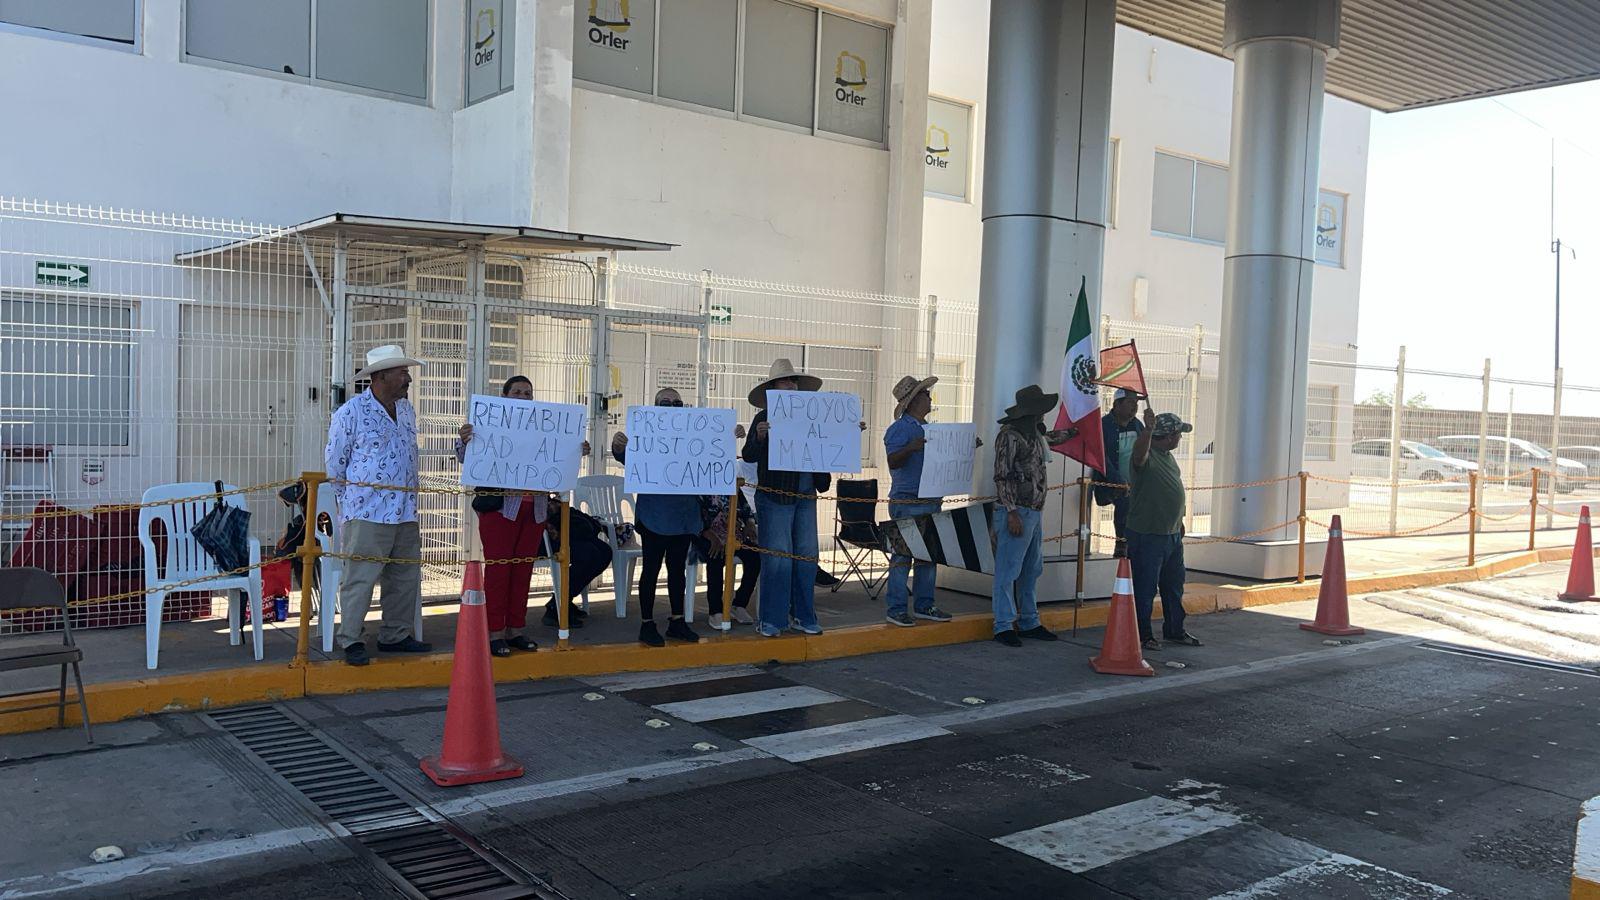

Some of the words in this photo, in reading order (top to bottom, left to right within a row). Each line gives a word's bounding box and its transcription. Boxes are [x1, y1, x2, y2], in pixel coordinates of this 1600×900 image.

[589, 27, 629, 50] Orler
[475, 48, 495, 66] Orler
[835, 87, 866, 106] Orler
[925, 154, 949, 169] Orler
[1316, 234, 1336, 248] Orler
[773, 393, 859, 423] APOYOS
[633, 409, 725, 433] PRECIOS
[807, 422, 828, 439] AL
[471, 432, 514, 459] DAD
[534, 437, 564, 463] AL
[628, 435, 726, 458] JUSTOS
[779, 439, 847, 471] MAIZ
[469, 460, 563, 490] CAMPO
[629, 462, 658, 485] AL
[662, 459, 735, 488] CAMPO
